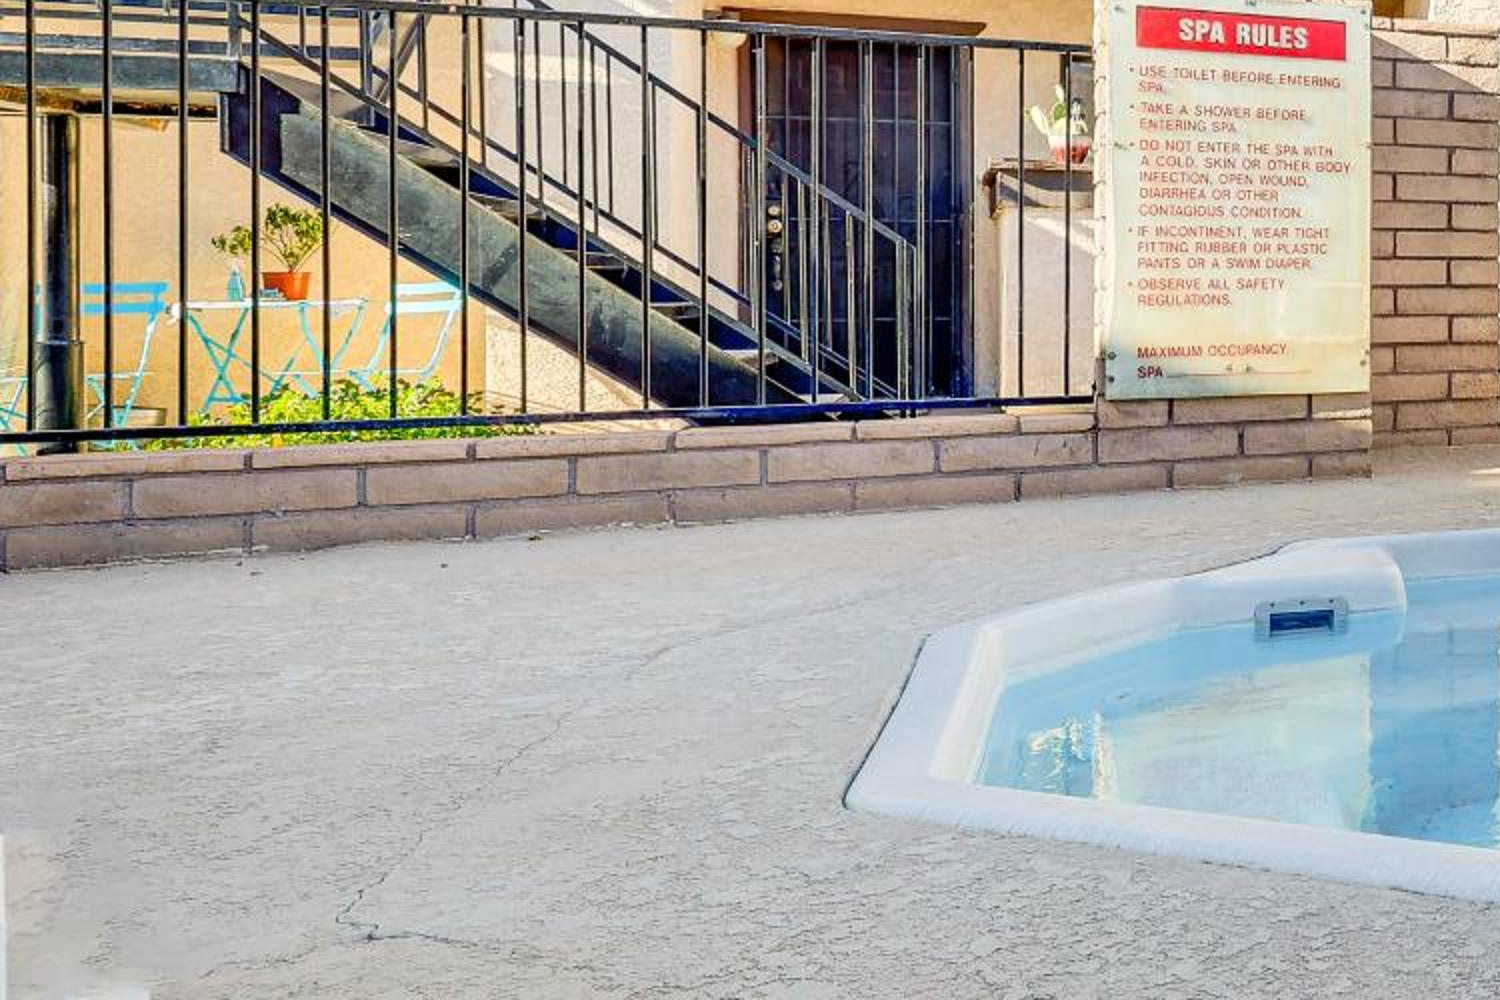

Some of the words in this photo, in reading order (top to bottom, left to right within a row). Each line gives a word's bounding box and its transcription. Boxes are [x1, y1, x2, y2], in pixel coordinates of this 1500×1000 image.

[1178, 17, 1226, 45] SPA
[1235, 22, 1309, 50] RULES
[1138, 65, 1167, 79] USE
[1173, 67, 1218, 82] TOILET
[1223, 69, 1274, 85] BEFORE
[1278, 74, 1342, 90] ENTERING
[1140, 102, 1173, 115] TAKE
[1179, 104, 1189, 115] A
[1194, 104, 1251, 118] SHOWER
[1255, 108, 1306, 121] BEFORE
[1139, 118, 1208, 133] ENTERING
[1138, 139, 1159, 151] DO
[1165, 139, 1192, 153] NOT
[1197, 141, 1241, 154] ENTER
[1247, 142, 1270, 155] THE
[1275, 144, 1299, 157] SPA
[1302, 146, 1334, 158] WITH
[1140, 155, 1150, 167] A
[1203, 156, 1236, 170] SKIN
[1241, 158, 1261, 171] OR
[1267, 159, 1312, 173] OTHER
[1315, 161, 1351, 175] BODY
[1139, 171, 1214, 185] INFECTION,
[1217, 173, 1254, 186] OPEN
[1259, 174, 1310, 188] WOUND,
[1138, 187, 1207, 200] DIARRHEA
[1211, 189, 1231, 201] OR
[1236, 189, 1280, 203] OTHER
[1138, 203, 1225, 218] CONTAGIOUS
[1136, 226, 1151, 238] IF
[1154, 225, 1248, 240] INCONTINENT,
[1252, 227, 1290, 239] WEAR
[1294, 227, 1330, 240] TIGHT
[1137, 241, 1189, 254] FITTING
[1194, 242, 1247, 254] RUBBER
[1253, 243, 1271, 255] OR
[1277, 243, 1328, 255] PLASTIC
[1136, 258, 1181, 270] PANTS
[1187, 258, 1205, 270] OR
[1211, 258, 1220, 270] A
[1226, 258, 1261, 270] SWIM
[1137, 277, 1201, 291] OBSERVE
[1207, 278, 1231, 290] ALL
[1235, 277, 1286, 291] SAFETY
[1137, 346, 1204, 359] MAXIMUM
[1207, 344, 1288, 357] OCCUPANCY
[1137, 366, 1164, 379] SPA
